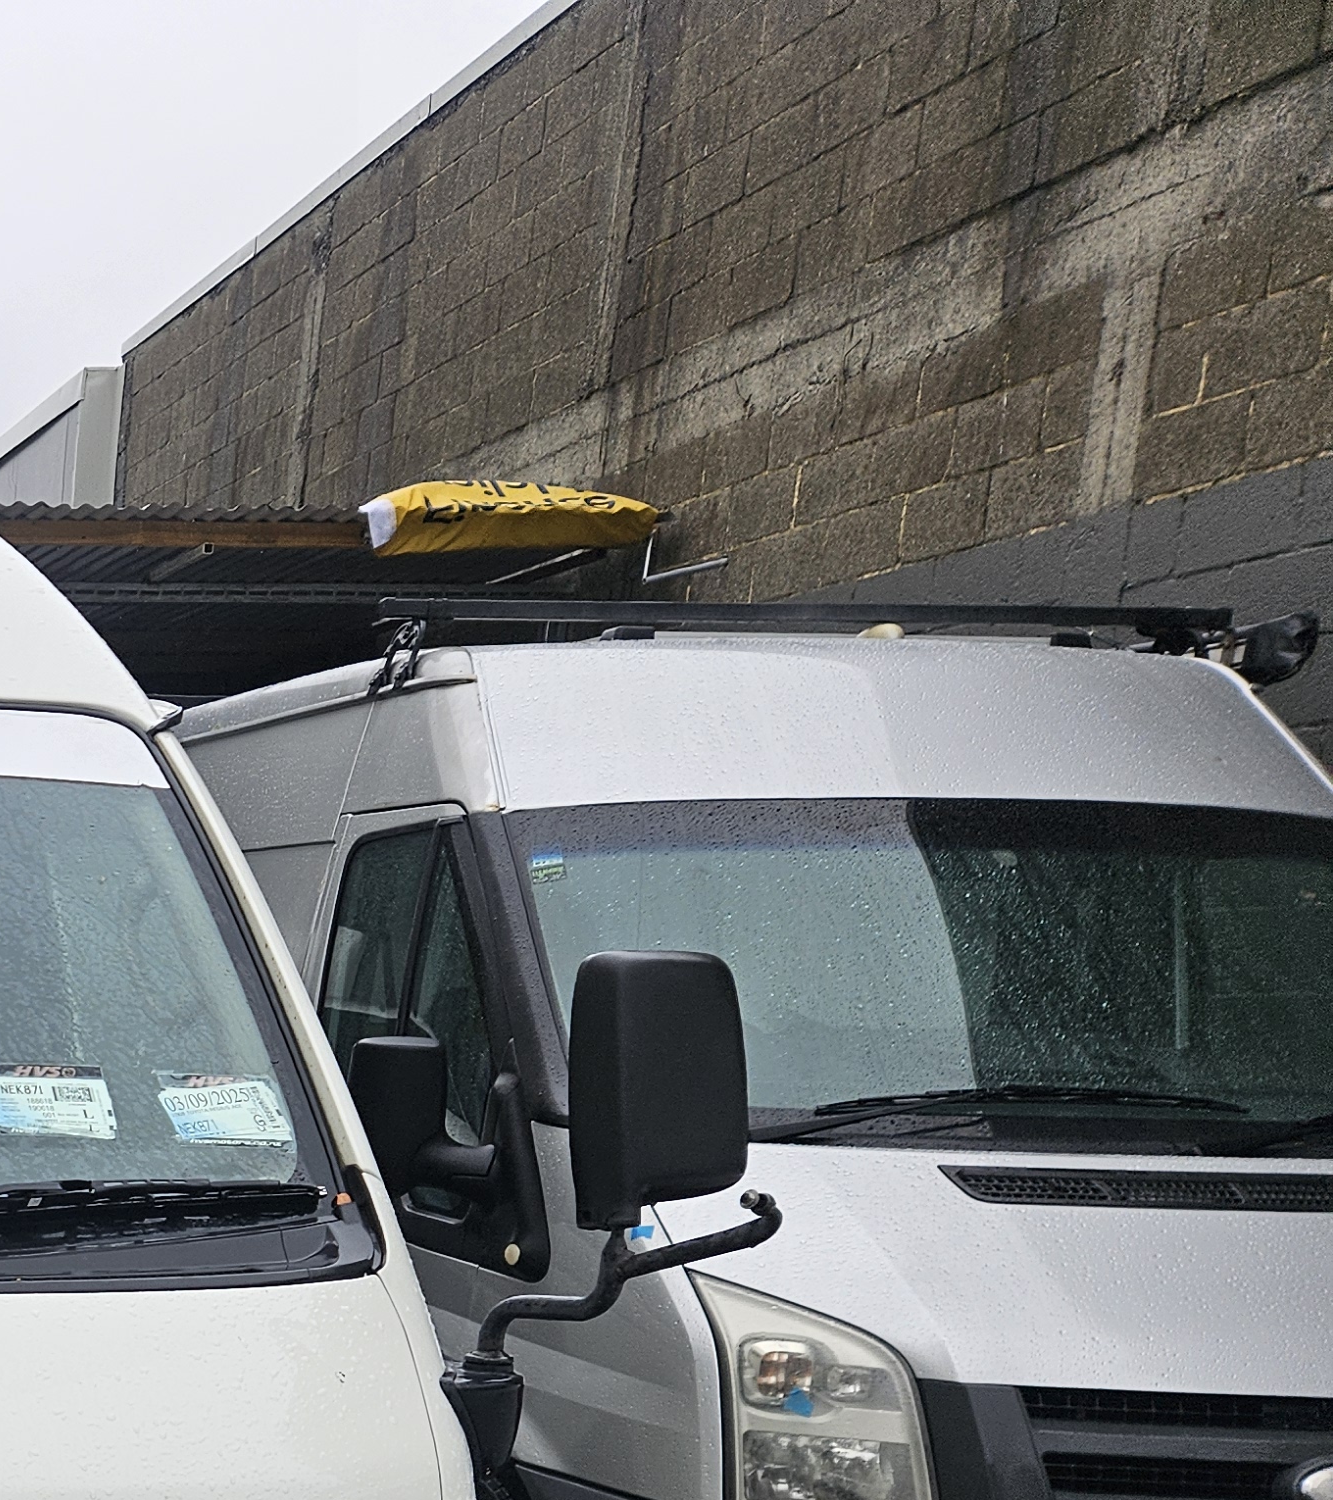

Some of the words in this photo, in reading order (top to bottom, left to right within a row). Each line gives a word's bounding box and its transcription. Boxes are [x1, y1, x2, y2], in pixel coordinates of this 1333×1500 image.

[0, 1084, 44, 1095] NEK871
[163, 1087, 250, 1112] 03/09/2025
[176, 1119, 218, 1135] NEK871
